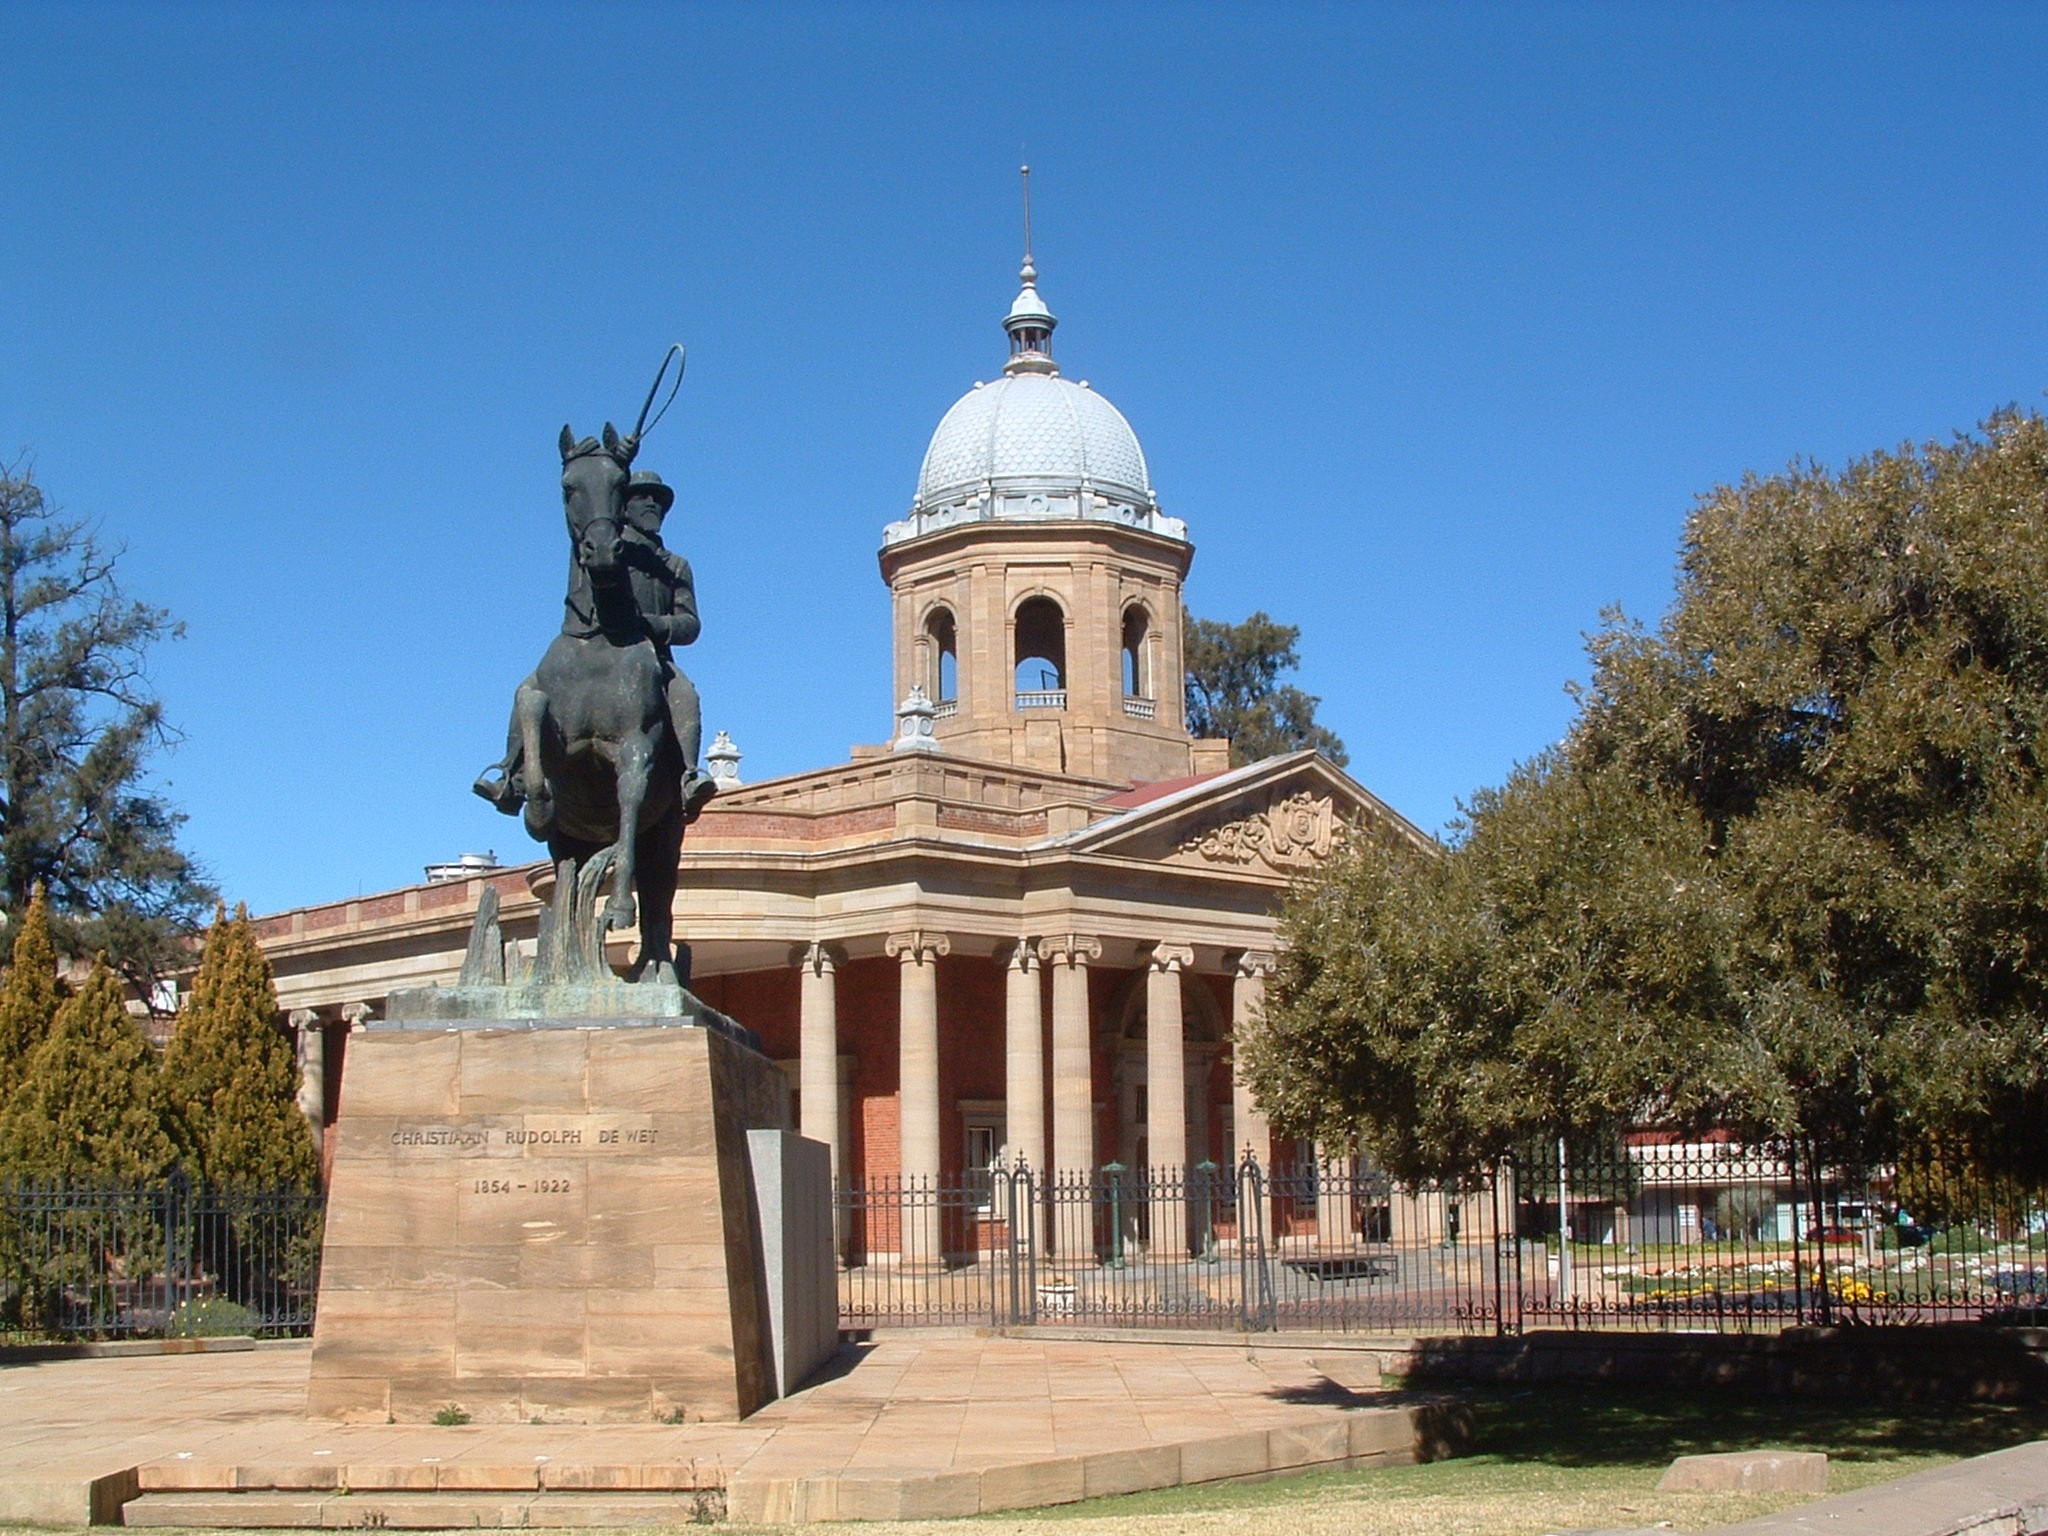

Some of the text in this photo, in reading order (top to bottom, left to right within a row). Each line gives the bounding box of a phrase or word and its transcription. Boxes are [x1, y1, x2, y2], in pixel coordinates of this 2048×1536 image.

[391, 1129, 659, 1146] CHRISTIAAN RUDOLPH DE WET
[474, 1180, 511, 1194] 1854
[533, 1179, 570, 1194] 1922
